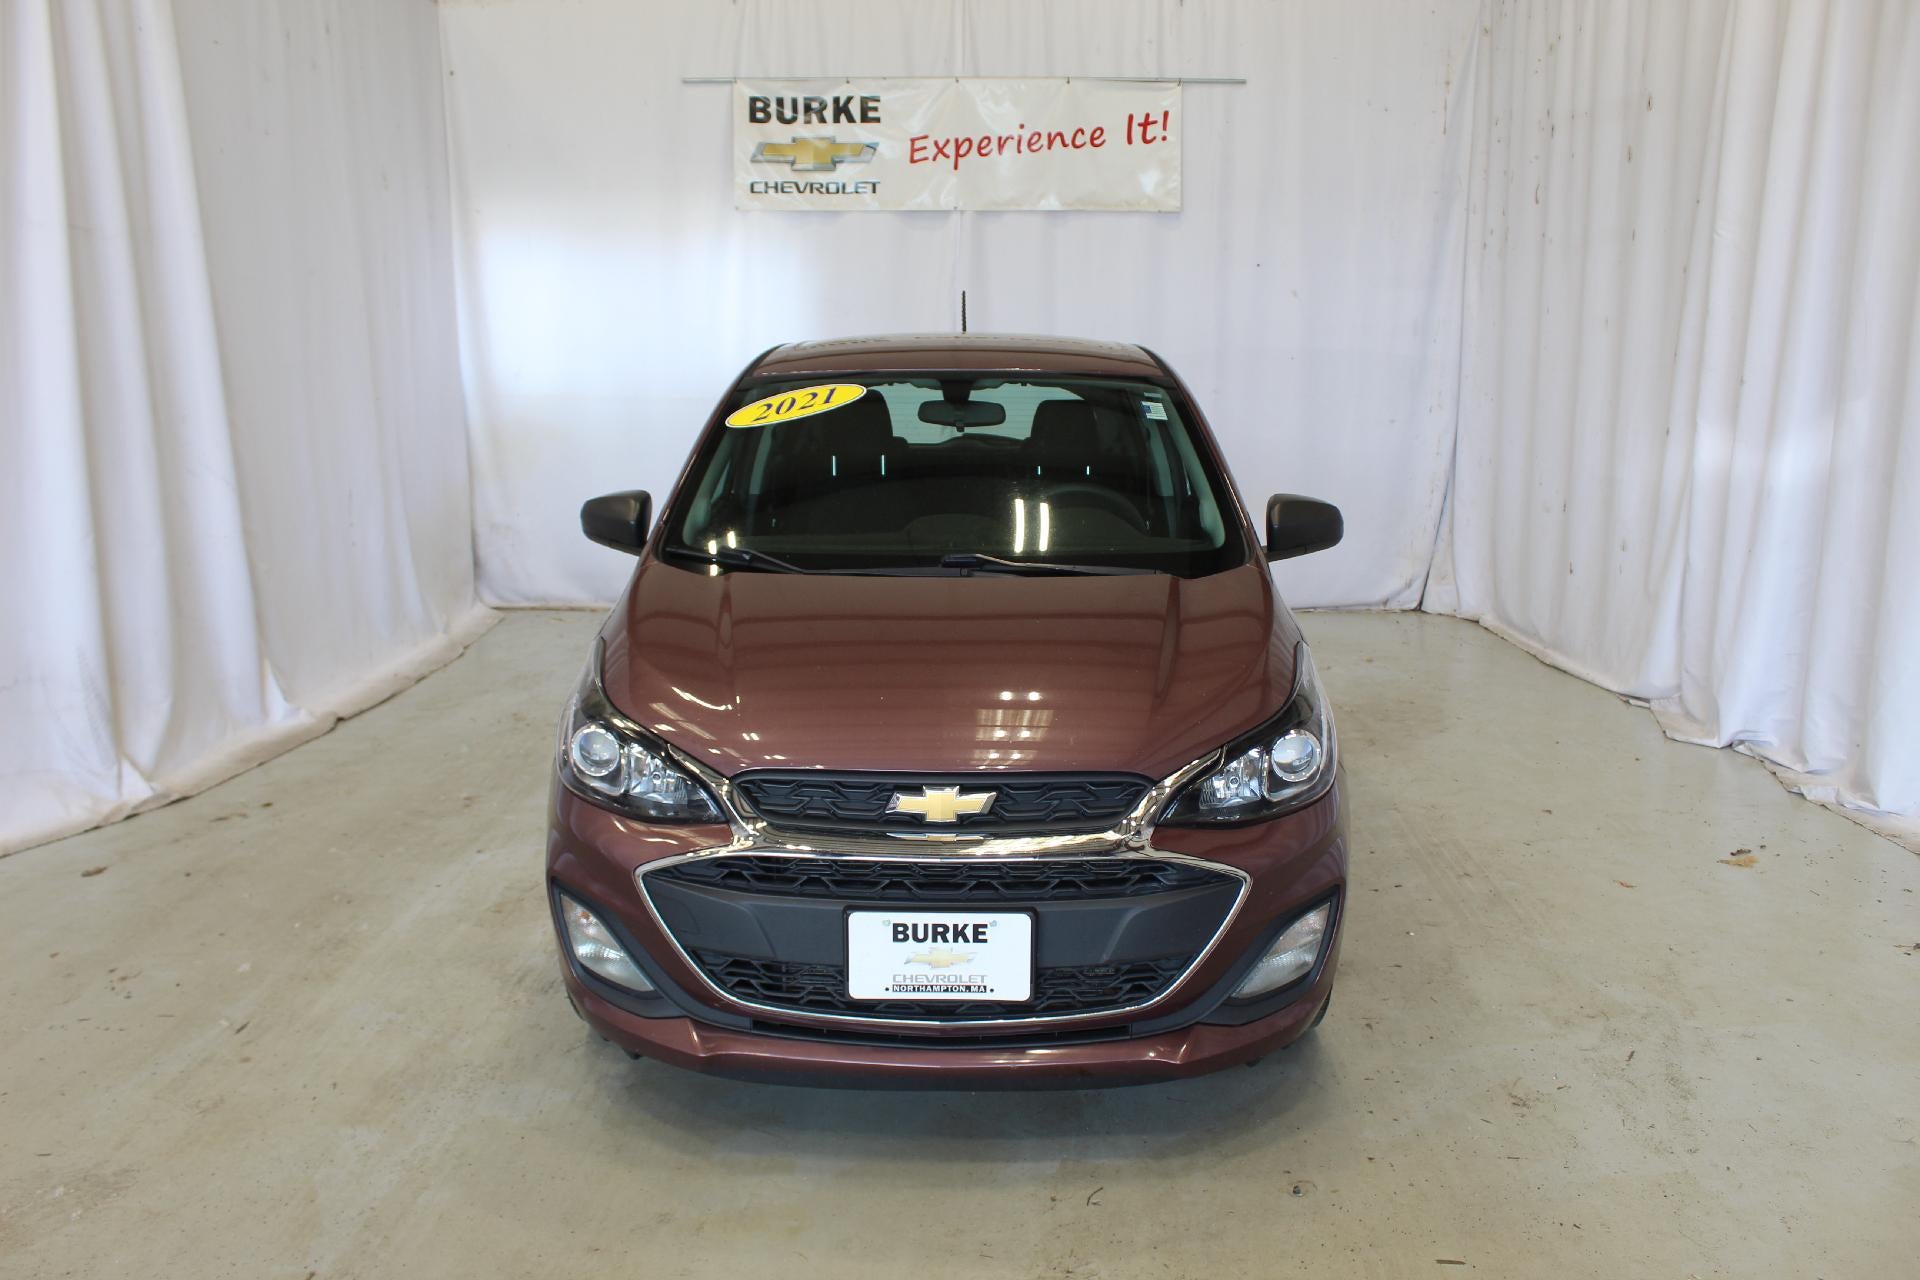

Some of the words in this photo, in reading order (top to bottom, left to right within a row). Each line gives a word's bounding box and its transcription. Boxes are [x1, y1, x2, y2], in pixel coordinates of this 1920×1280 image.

[748, 95, 881, 125] BURKE
[908, 123, 1106, 170] Experience
[1126, 110, 1170, 146] It!
[750, 180, 881, 195] CHEVROLET
[752, 387, 837, 421] 2021
[892, 923, 988, 943] BURKE
[892, 974, 988, 984] CHEVROLET
[970, 985, 986, 993] MA
